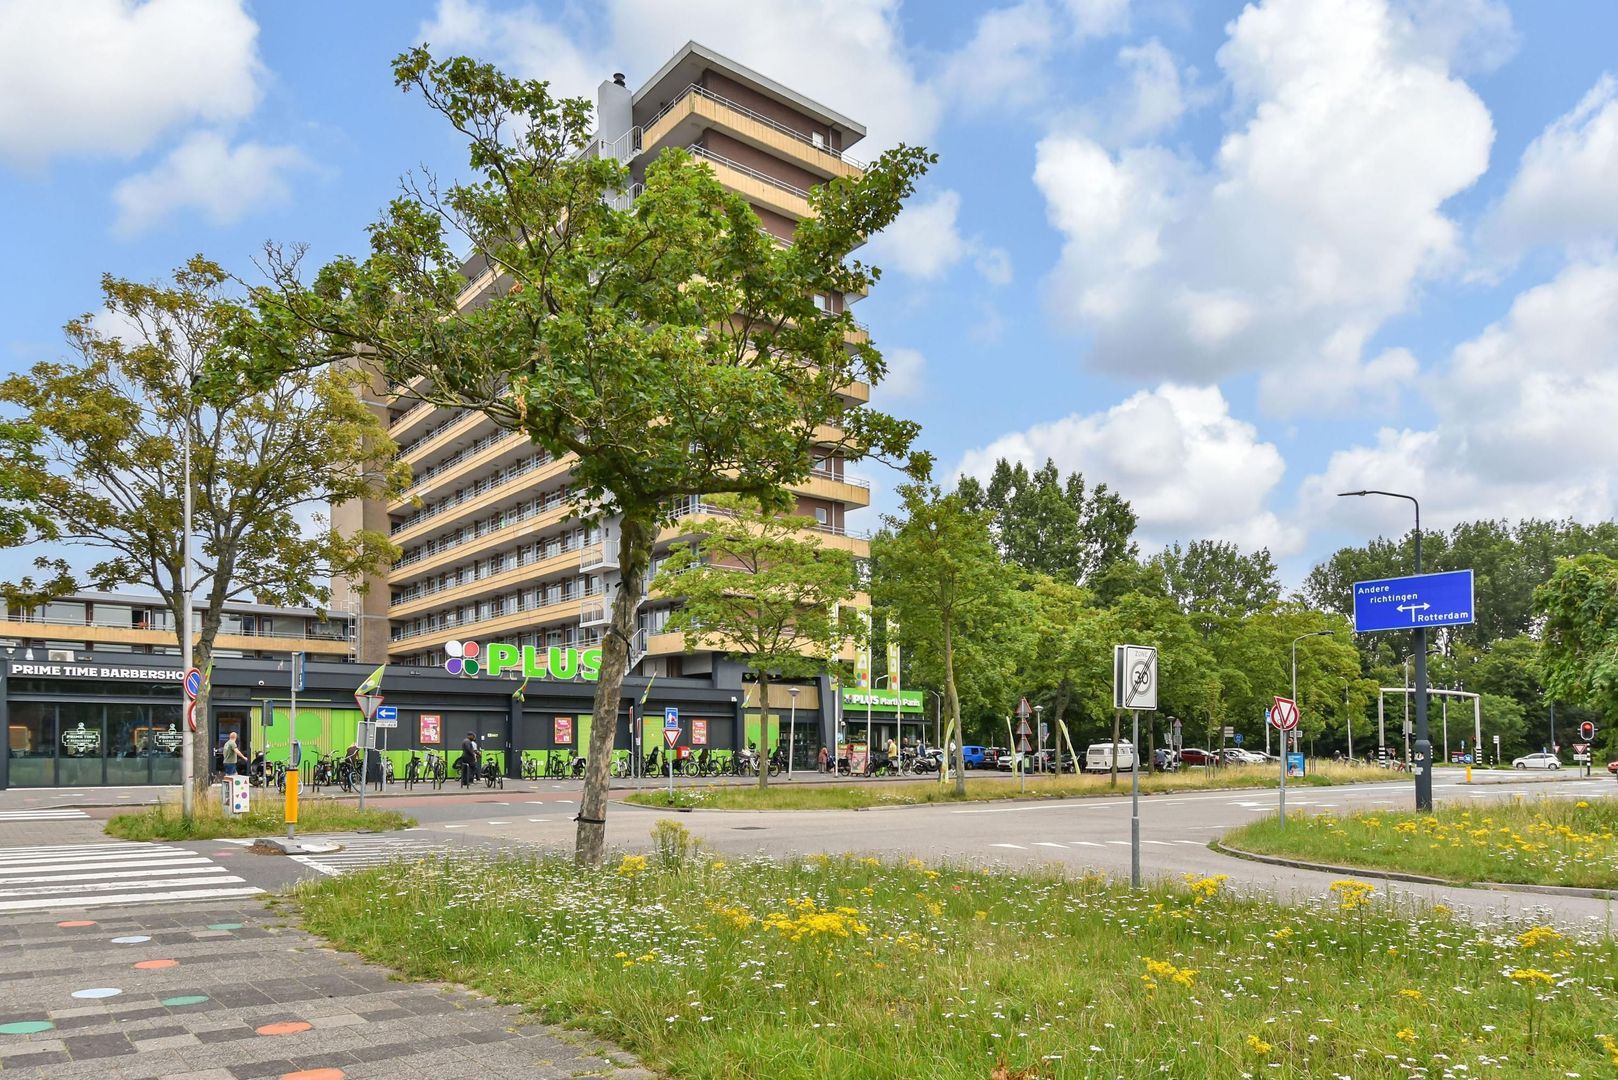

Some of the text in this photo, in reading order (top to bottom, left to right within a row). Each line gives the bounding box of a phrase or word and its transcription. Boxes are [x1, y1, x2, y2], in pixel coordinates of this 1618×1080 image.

[1358, 585, 1389, 594] Andere
[1370, 593, 1418, 603] richtingen
[1418, 612, 1468, 622] Rotterdam
[486, 642, 602, 681] PLUS
[11, 664, 184, 680] PRIME TIME BARBERSHO
[1134, 670, 1149, 685] 30
[852, 694, 879, 705] PLUS
